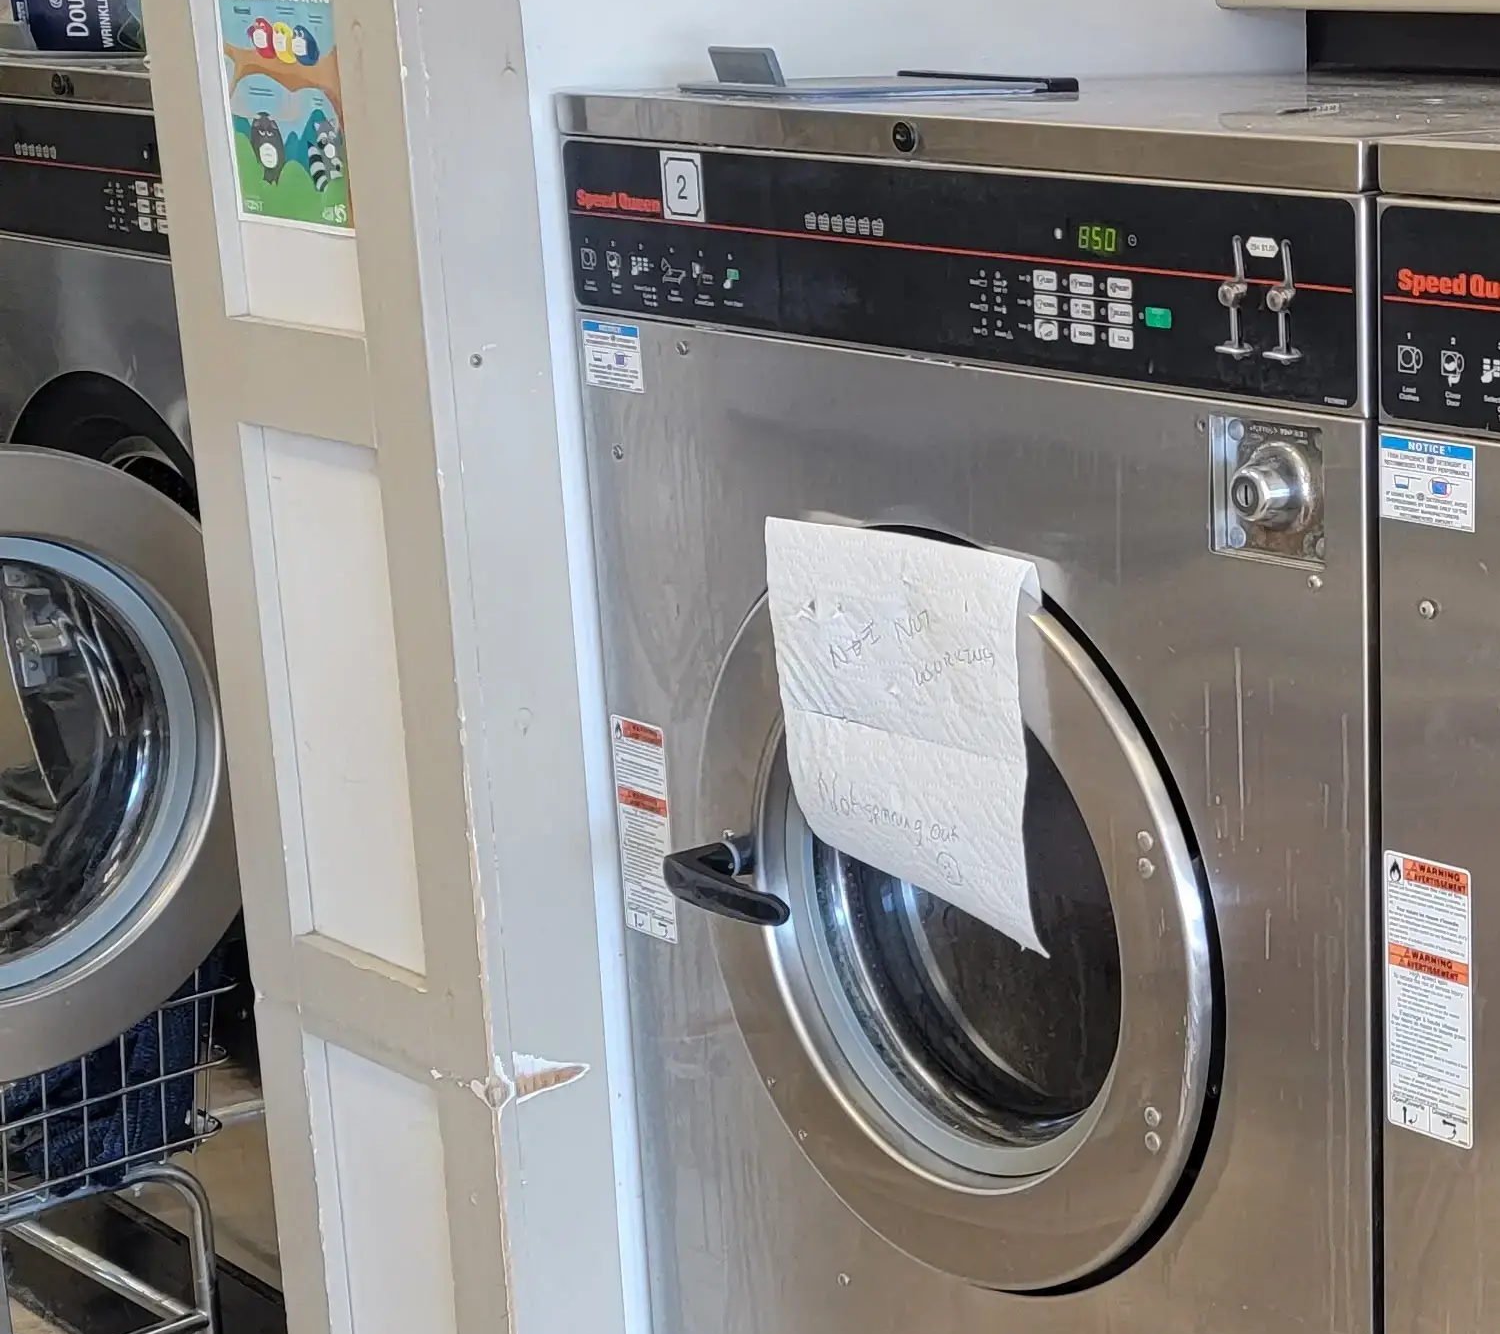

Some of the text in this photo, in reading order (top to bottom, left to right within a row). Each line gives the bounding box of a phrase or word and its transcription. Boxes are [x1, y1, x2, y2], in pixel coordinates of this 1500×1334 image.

[676, 174, 688, 200] 2
[576, 188, 618, 210] Speed
[1398, 269, 1467, 296] Speed
[1450, 337, 1456, 345] 2
[1407, 441, 1446, 454] NOTICE
[1413, 873, 1466, 893] AVERTISSEMENT
[1418, 864, 1460, 882] WARNING
[1411, 951, 1453, 969] WARNING
[1406, 960, 1459, 981] AVERTISSEMENT
